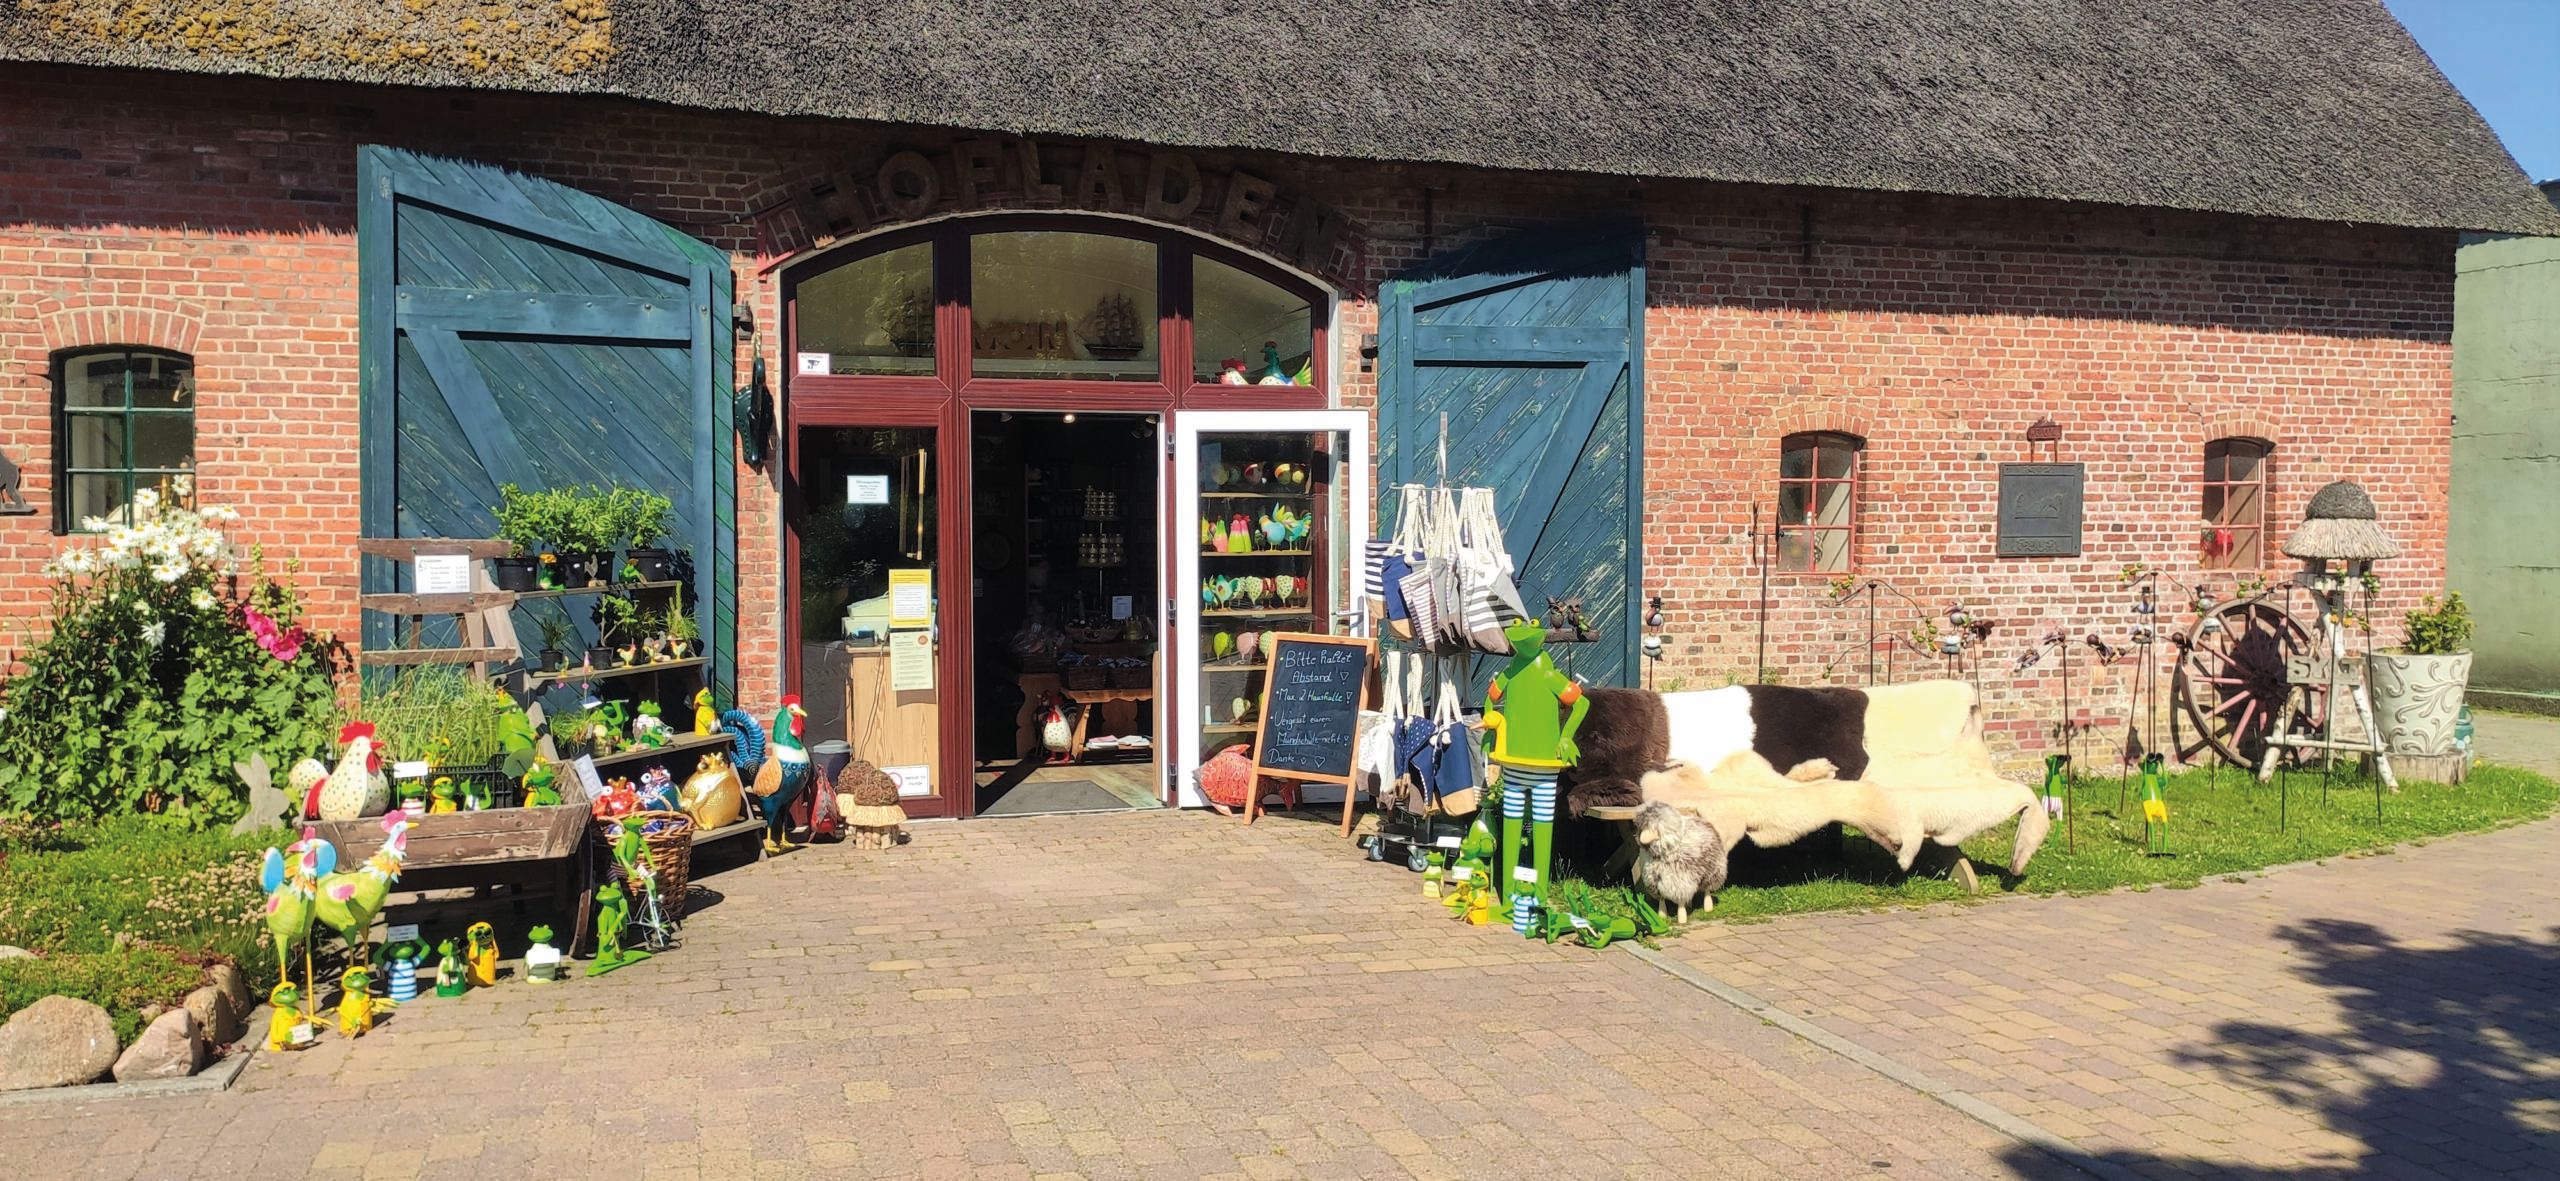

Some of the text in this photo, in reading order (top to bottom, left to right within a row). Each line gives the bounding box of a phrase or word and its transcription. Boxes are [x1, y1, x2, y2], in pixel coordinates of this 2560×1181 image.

[797, 138, 1341, 269] HOFLADEN
[1286, 650, 1352, 667] Bitte haltet
[1292, 670, 1333, 682] Abstand
[1299, 689, 1307, 701] 2
[1268, 748, 1295, 763] Danke
